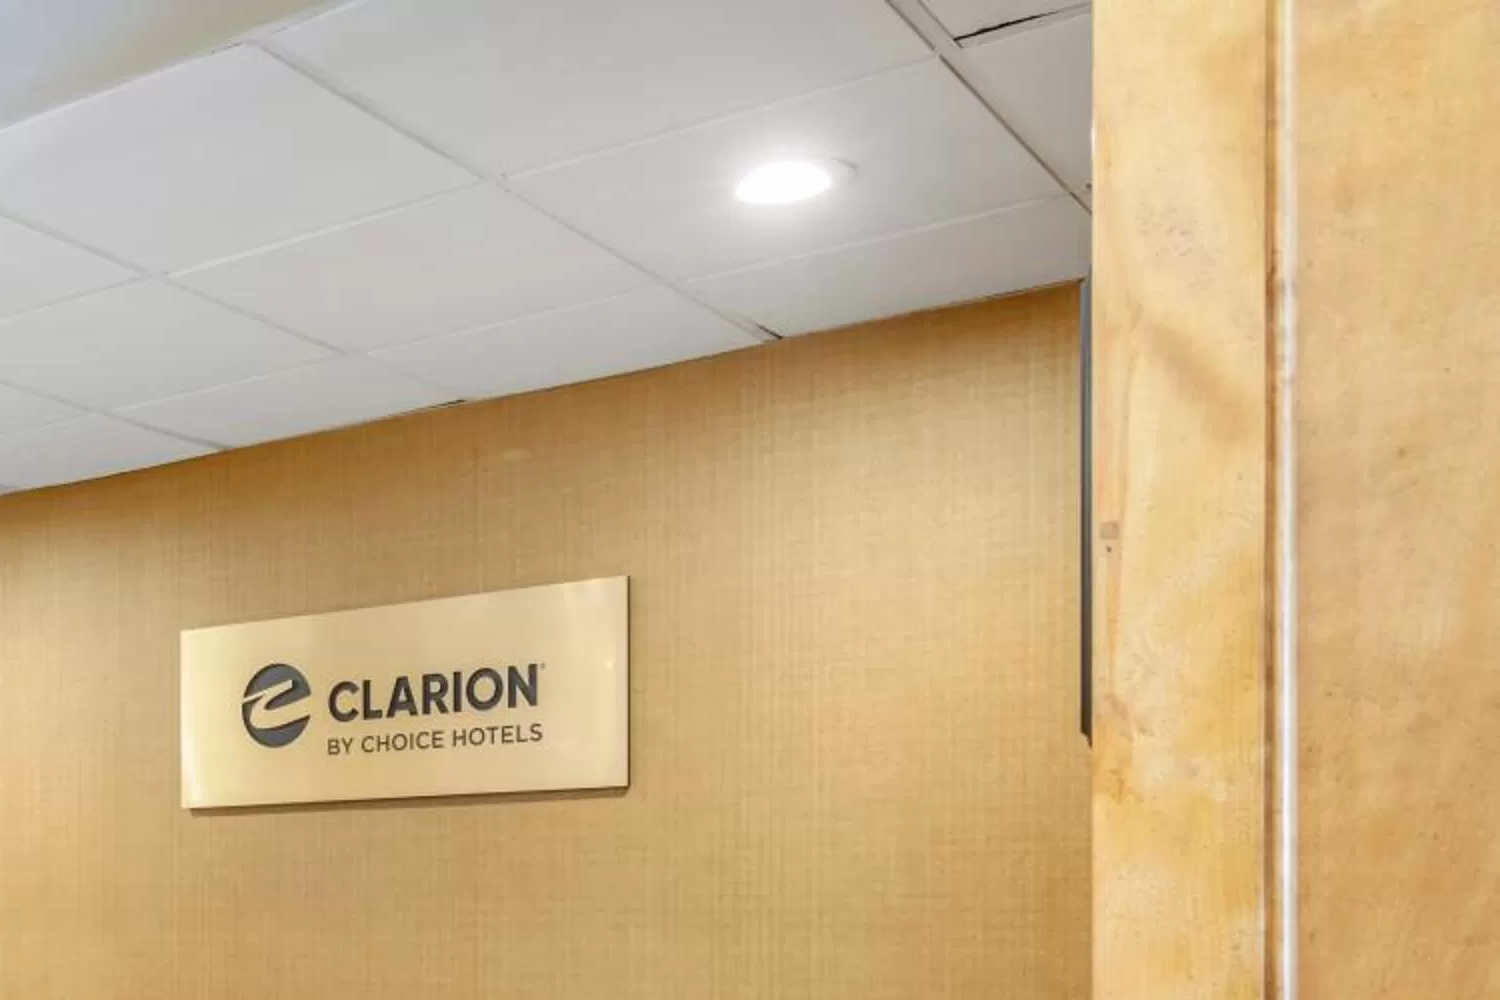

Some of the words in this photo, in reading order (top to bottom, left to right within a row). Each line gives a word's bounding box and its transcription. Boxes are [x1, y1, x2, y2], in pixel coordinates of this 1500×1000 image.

[328, 664, 538, 722] CLARION
[327, 738, 353, 755] BY
[361, 731, 444, 753] CHOICE
[453, 723, 543, 747] HOTELS
